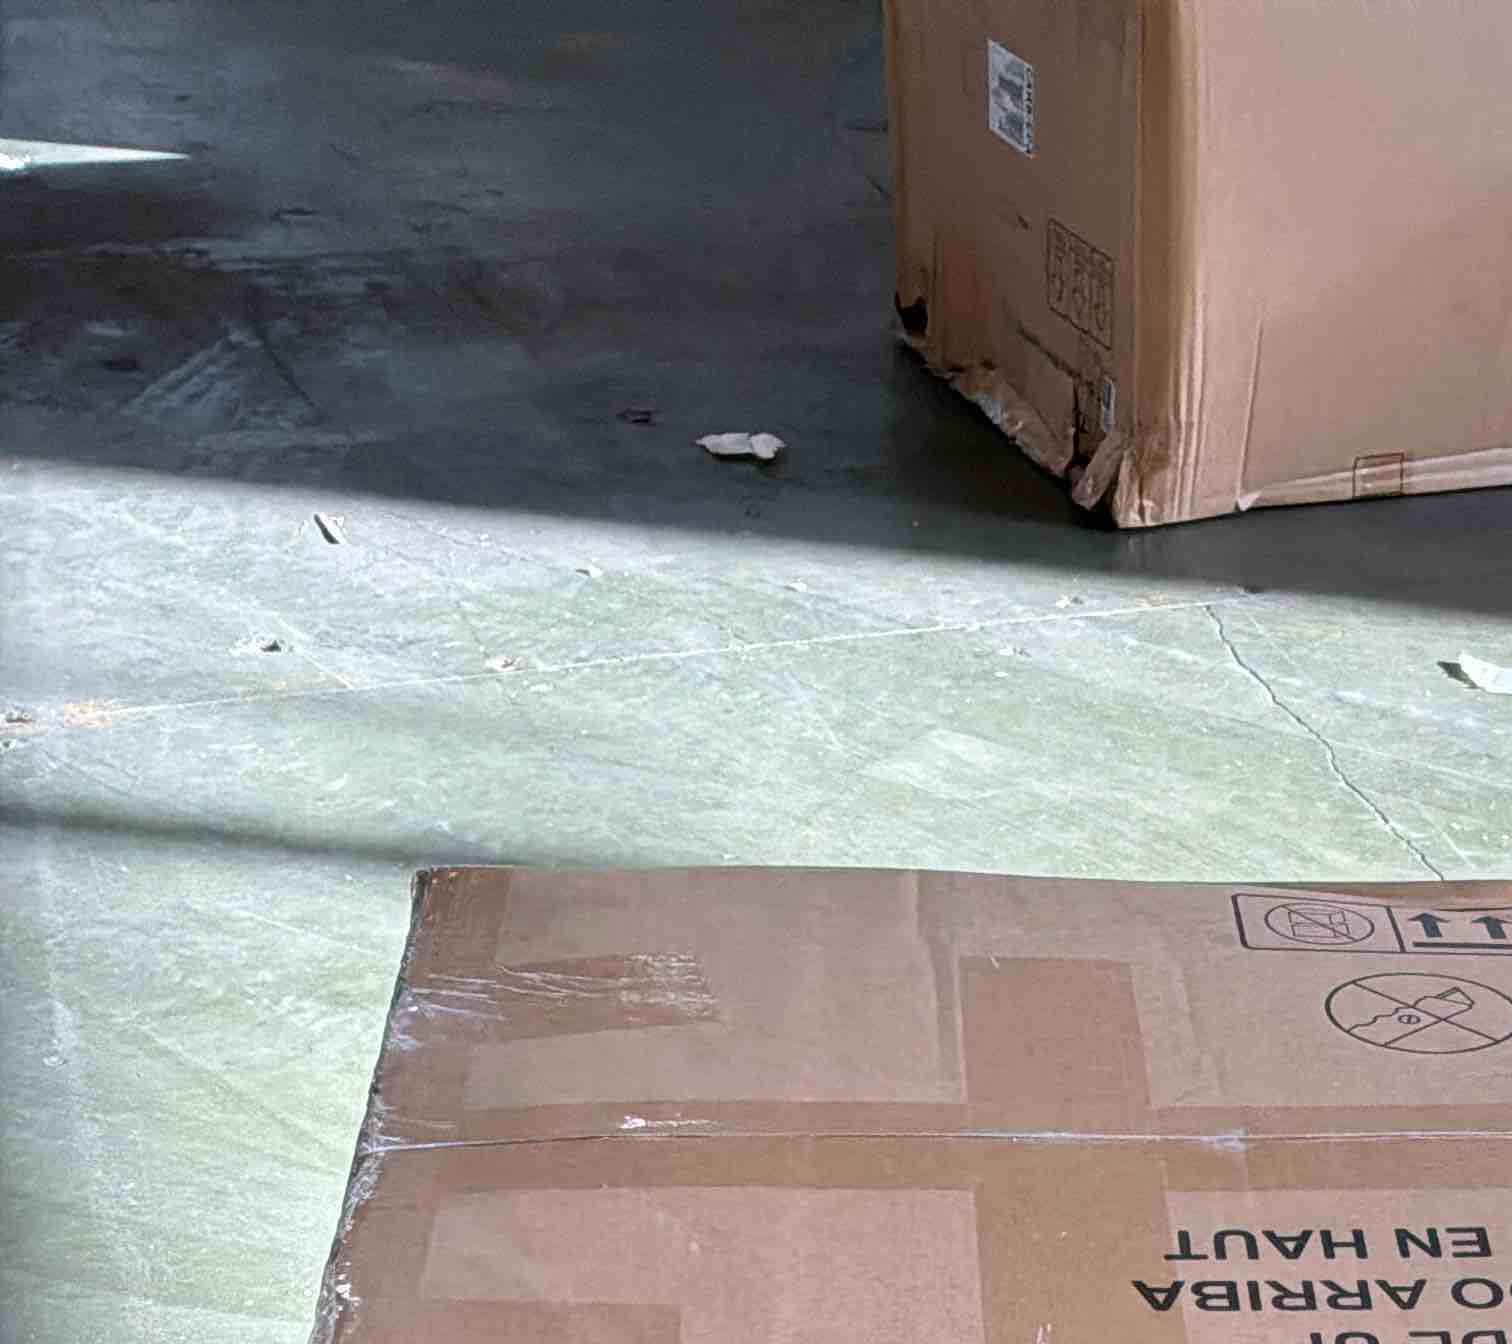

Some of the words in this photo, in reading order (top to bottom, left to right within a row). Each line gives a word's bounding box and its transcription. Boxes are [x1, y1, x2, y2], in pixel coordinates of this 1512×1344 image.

[1164, 1229, 1365, 1260] HAUT
[1395, 1227, 1488, 1258] EN
[1132, 1279, 1427, 1311] ARRIBA
